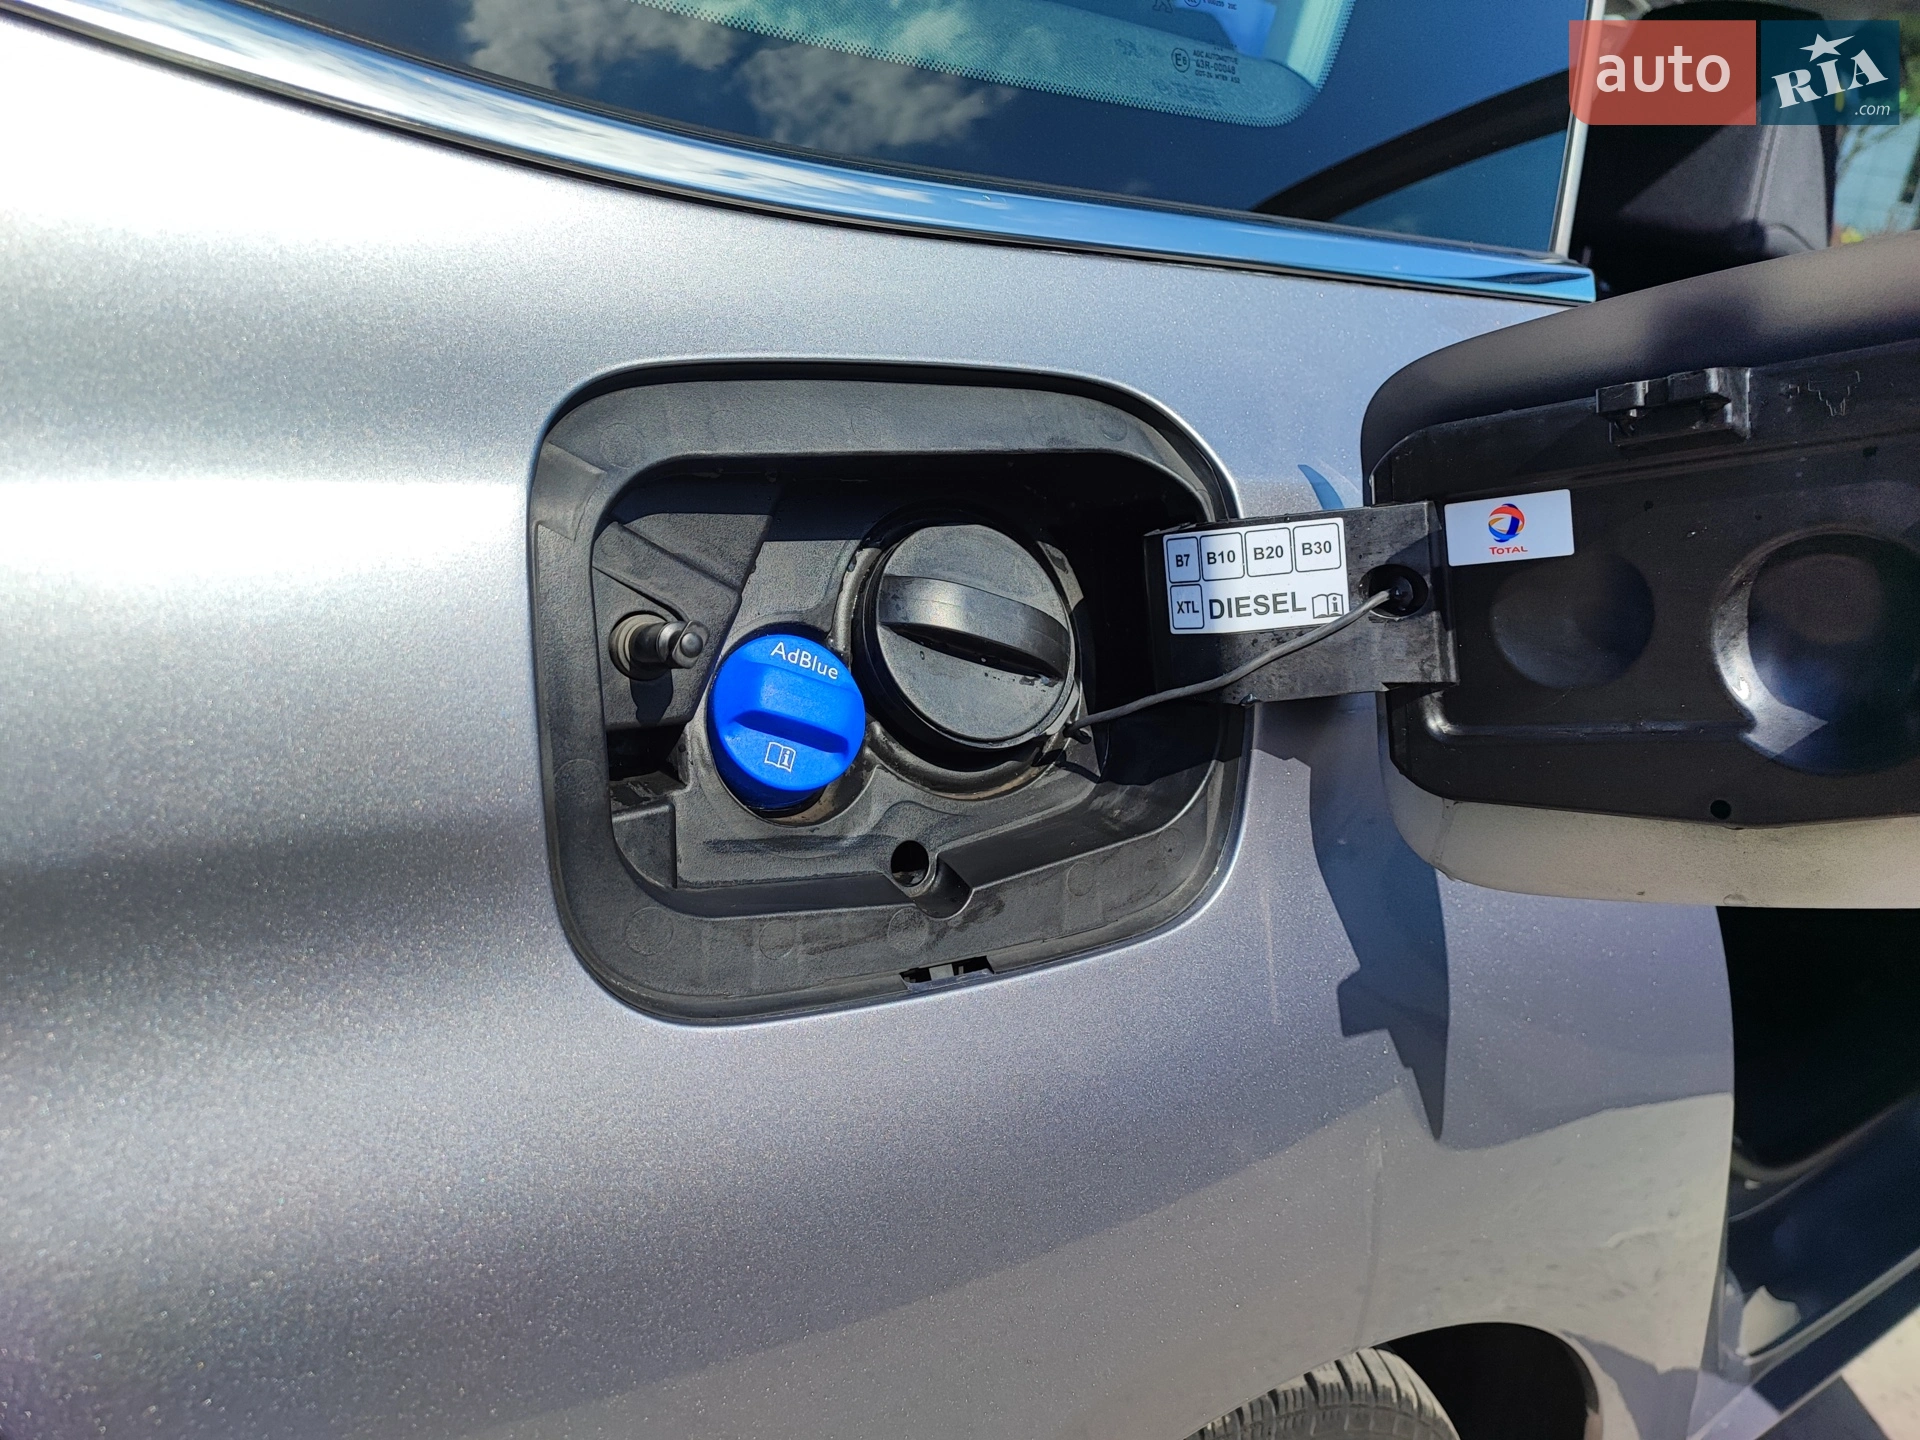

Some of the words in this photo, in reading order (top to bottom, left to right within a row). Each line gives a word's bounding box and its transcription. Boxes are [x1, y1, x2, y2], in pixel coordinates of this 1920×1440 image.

[1253, 545, 1284, 561] B20
[1301, 540, 1332, 556] B30
[1489, 546, 1528, 555] TOTAL
[1175, 554, 1191, 568] B7
[1206, 550, 1236, 565] B10
[1176, 600, 1200, 615] XTL
[1208, 591, 1307, 620] DIESEL
[770, 641, 839, 680] AdBlue
